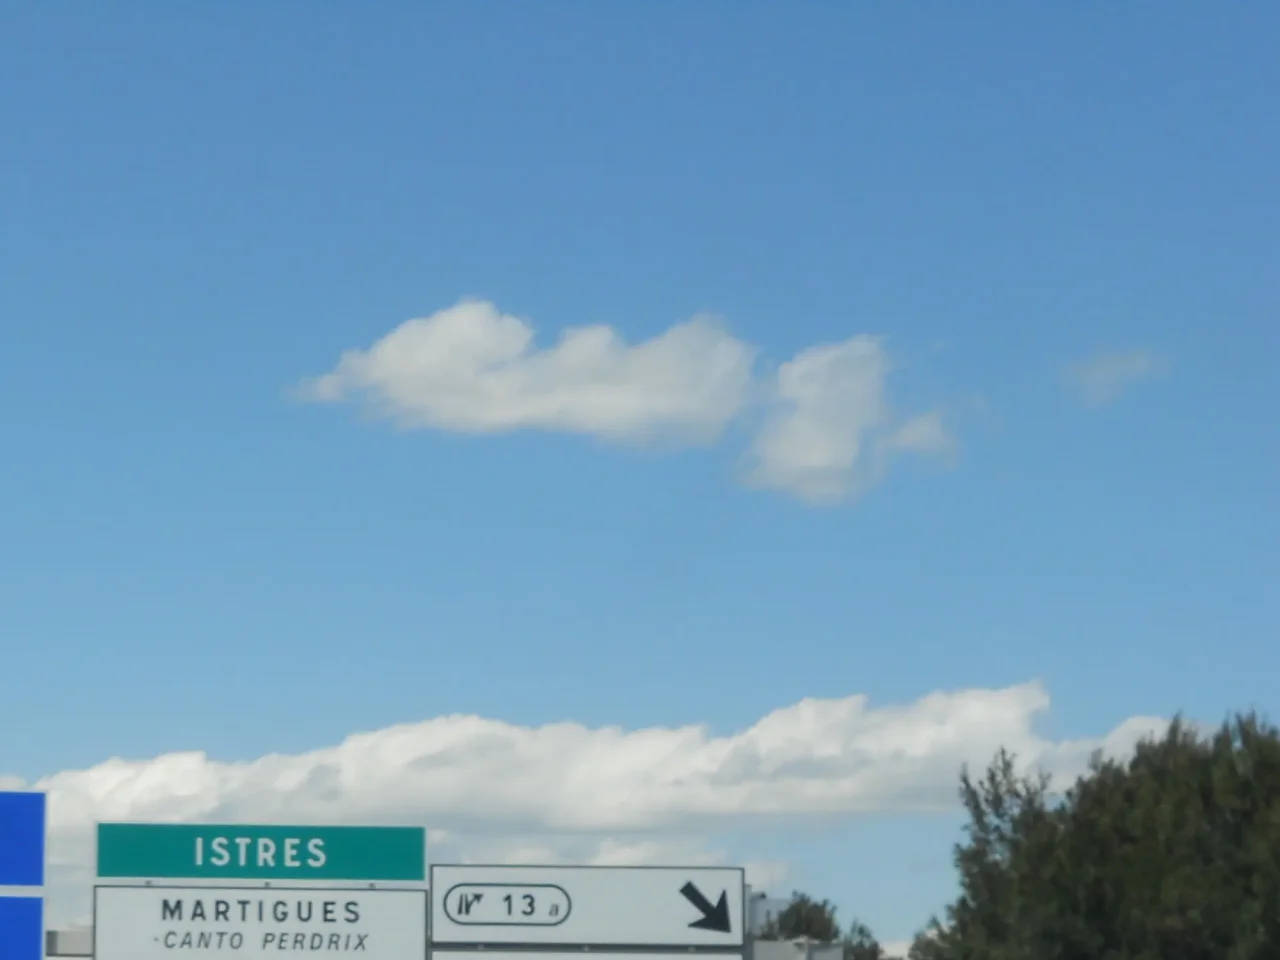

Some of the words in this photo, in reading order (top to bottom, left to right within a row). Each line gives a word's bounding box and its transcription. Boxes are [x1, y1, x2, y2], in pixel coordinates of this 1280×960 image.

[195, 836, 327, 868] ISTRES
[161, 899, 362, 924] MARTIGUES
[503, 893, 536, 917] 13
[261, 932, 370, 952] PERDRIX
